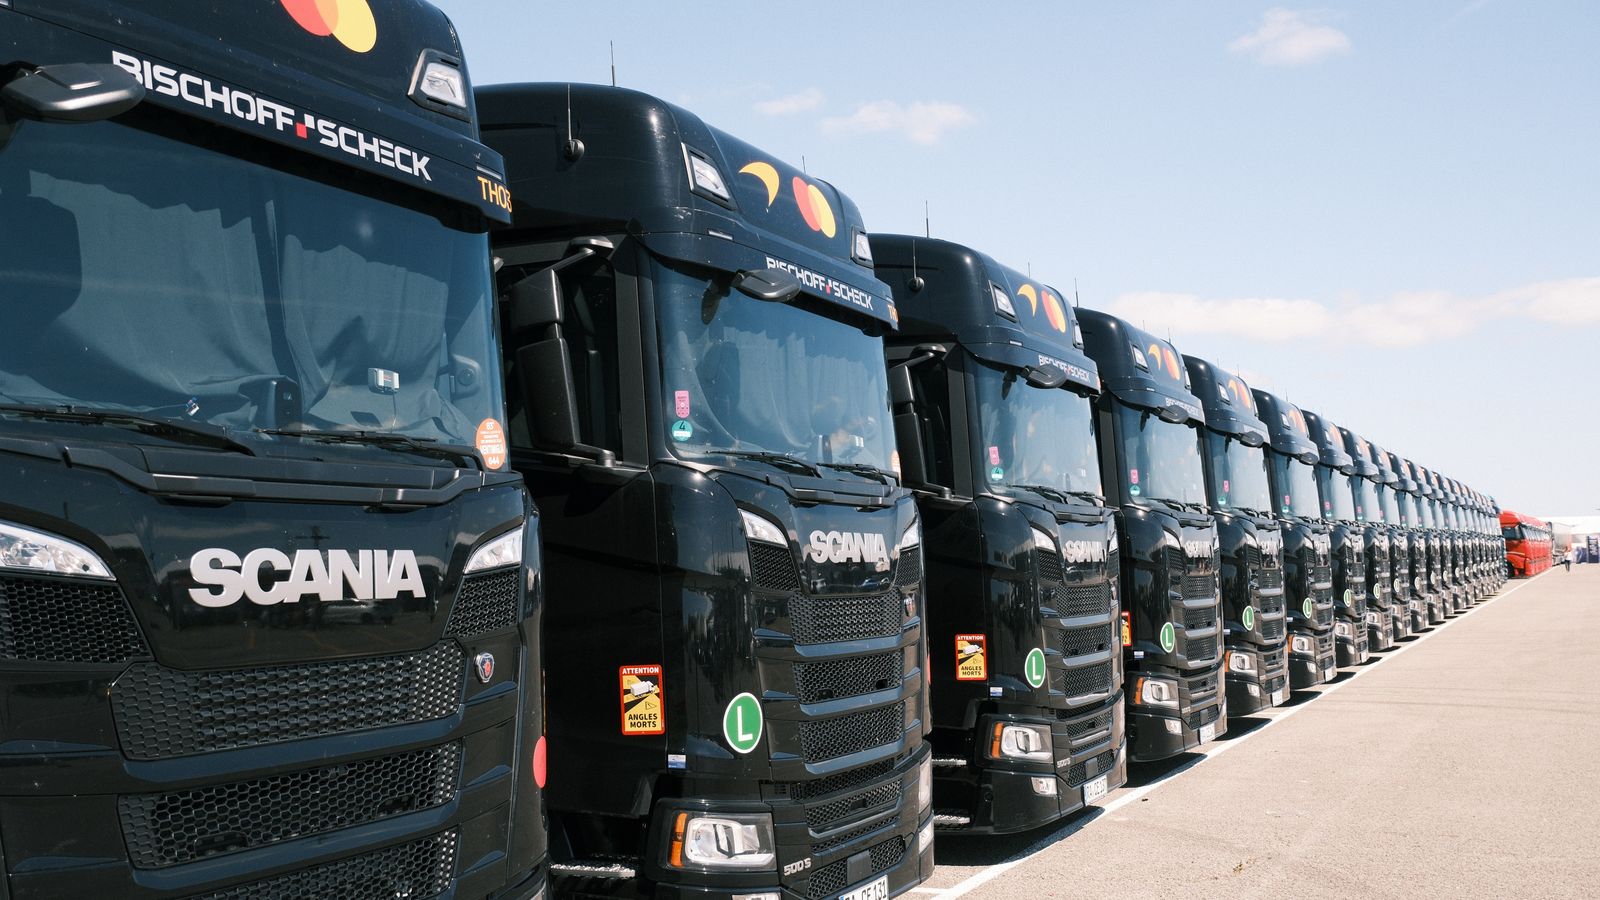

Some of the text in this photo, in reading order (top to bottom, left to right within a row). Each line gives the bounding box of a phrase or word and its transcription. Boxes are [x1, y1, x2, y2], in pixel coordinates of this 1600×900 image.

[112, 50, 432, 181] BISCHOFF SCHECK
[832, 280, 873, 310] SCHECK
[679, 421, 686, 431] 4
[809, 530, 889, 564] SCANIA
[188, 547, 427, 608] SCANIA
[1246, 610, 1252, 626] L
[1165, 626, 1172, 648] L
[622, 667, 659, 675] ATTENTION
[1032, 656, 1041, 681] L
[628, 713, 658, 721] ANGLES
[630, 721, 657, 729] MORTS
[737, 705, 753, 742] L
